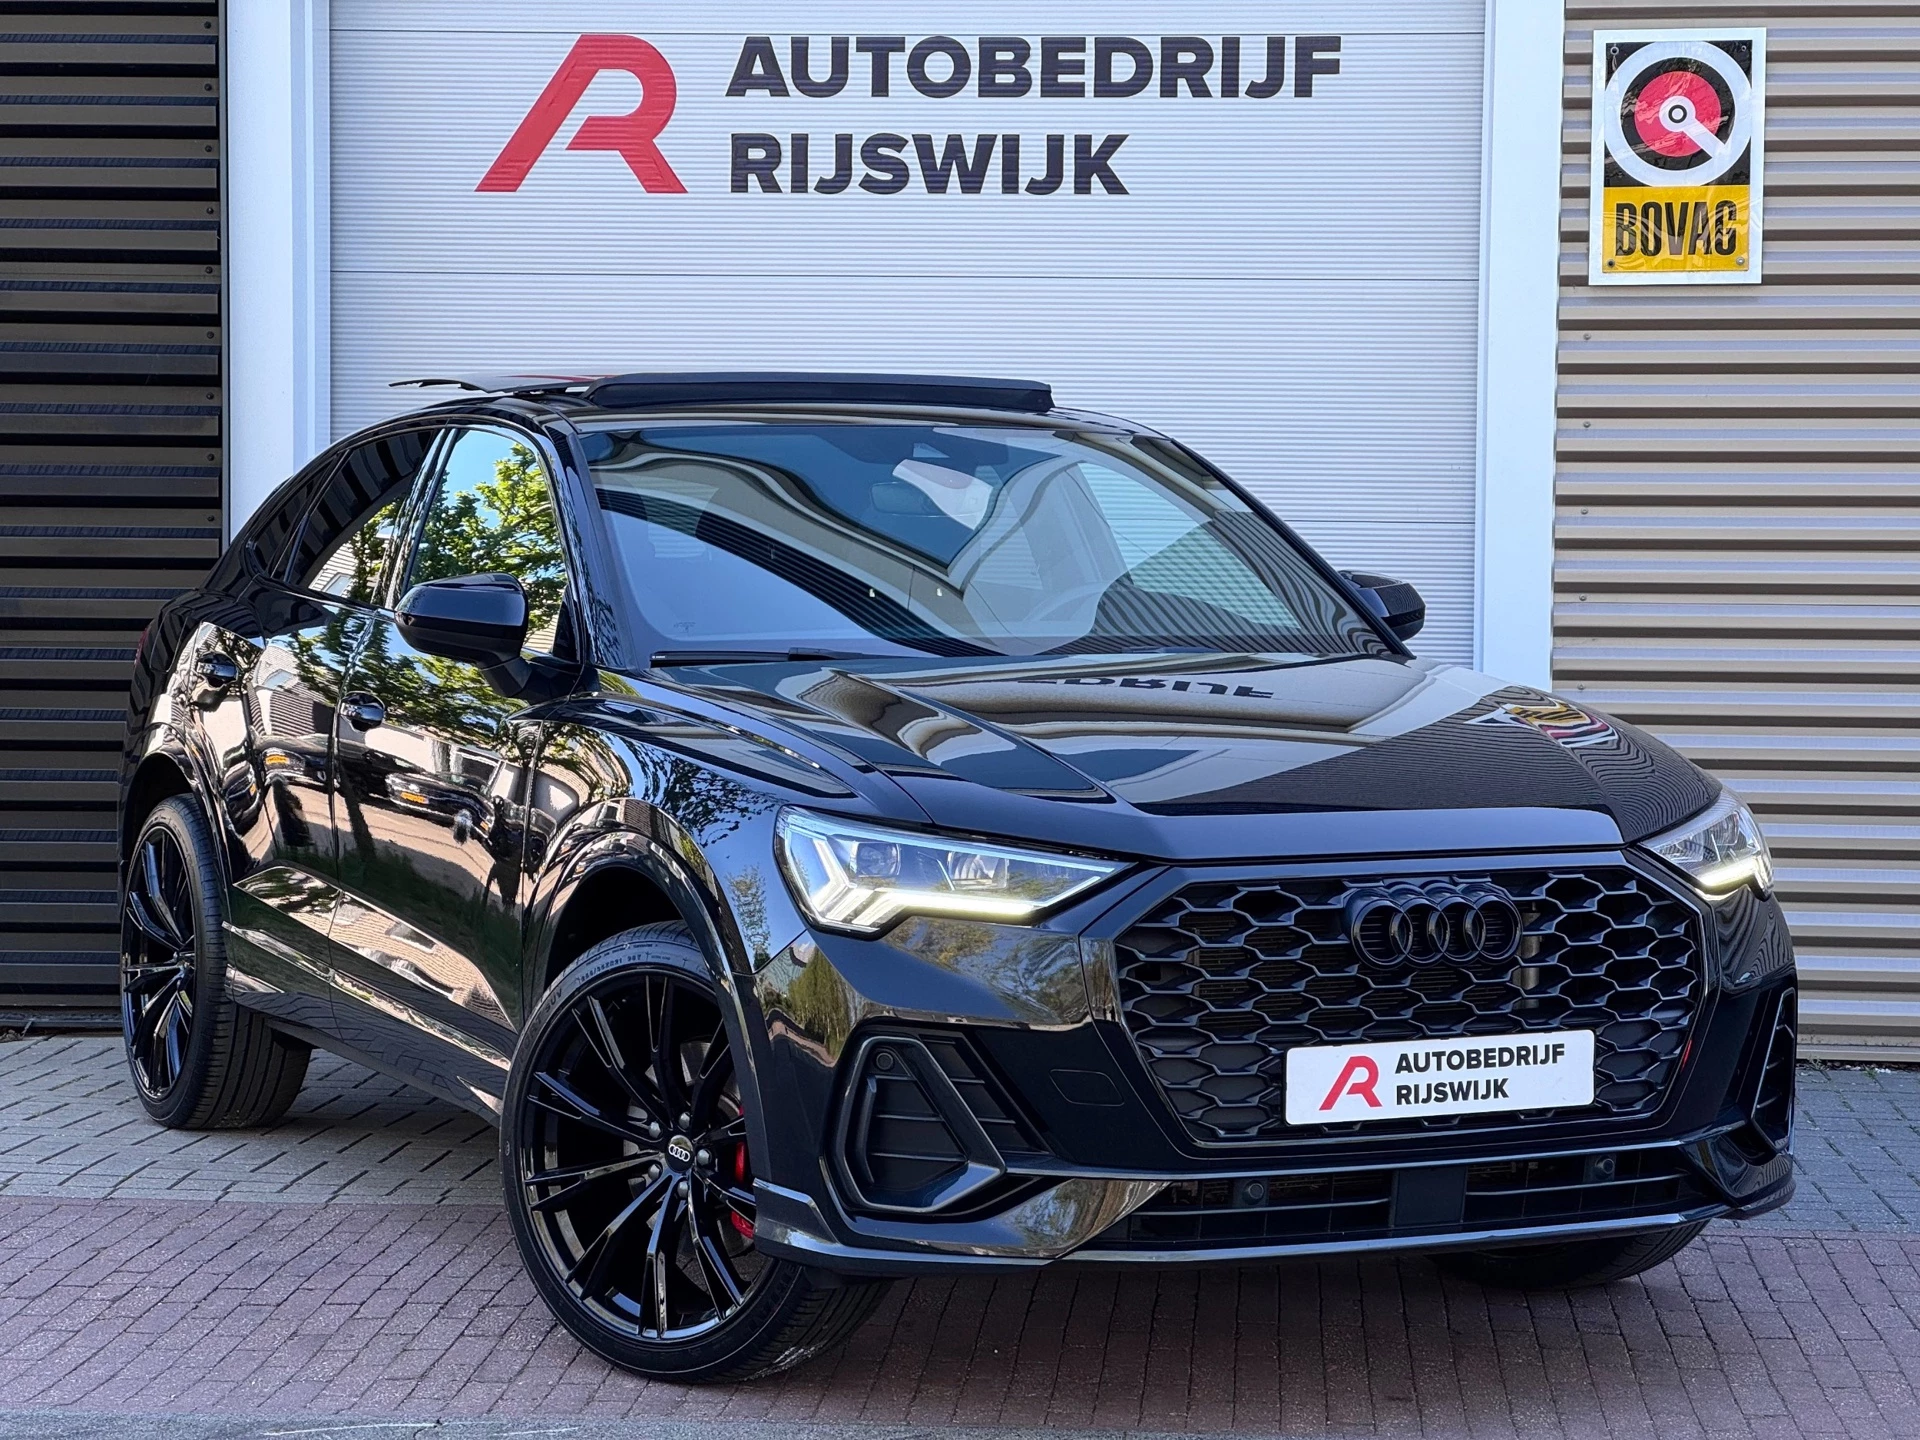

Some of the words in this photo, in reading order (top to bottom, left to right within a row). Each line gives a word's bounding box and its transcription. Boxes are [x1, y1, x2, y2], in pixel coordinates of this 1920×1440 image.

[726, 36, 1341, 98] AUTOBEDRIJF
[731, 133, 1129, 195] RIJSWIJK
[1615, 200, 1737, 256] BOVAG
[1395, 1043, 1565, 1074] AUTOBEDRIJF
[1396, 1078, 1509, 1106] RIJSWIJK
